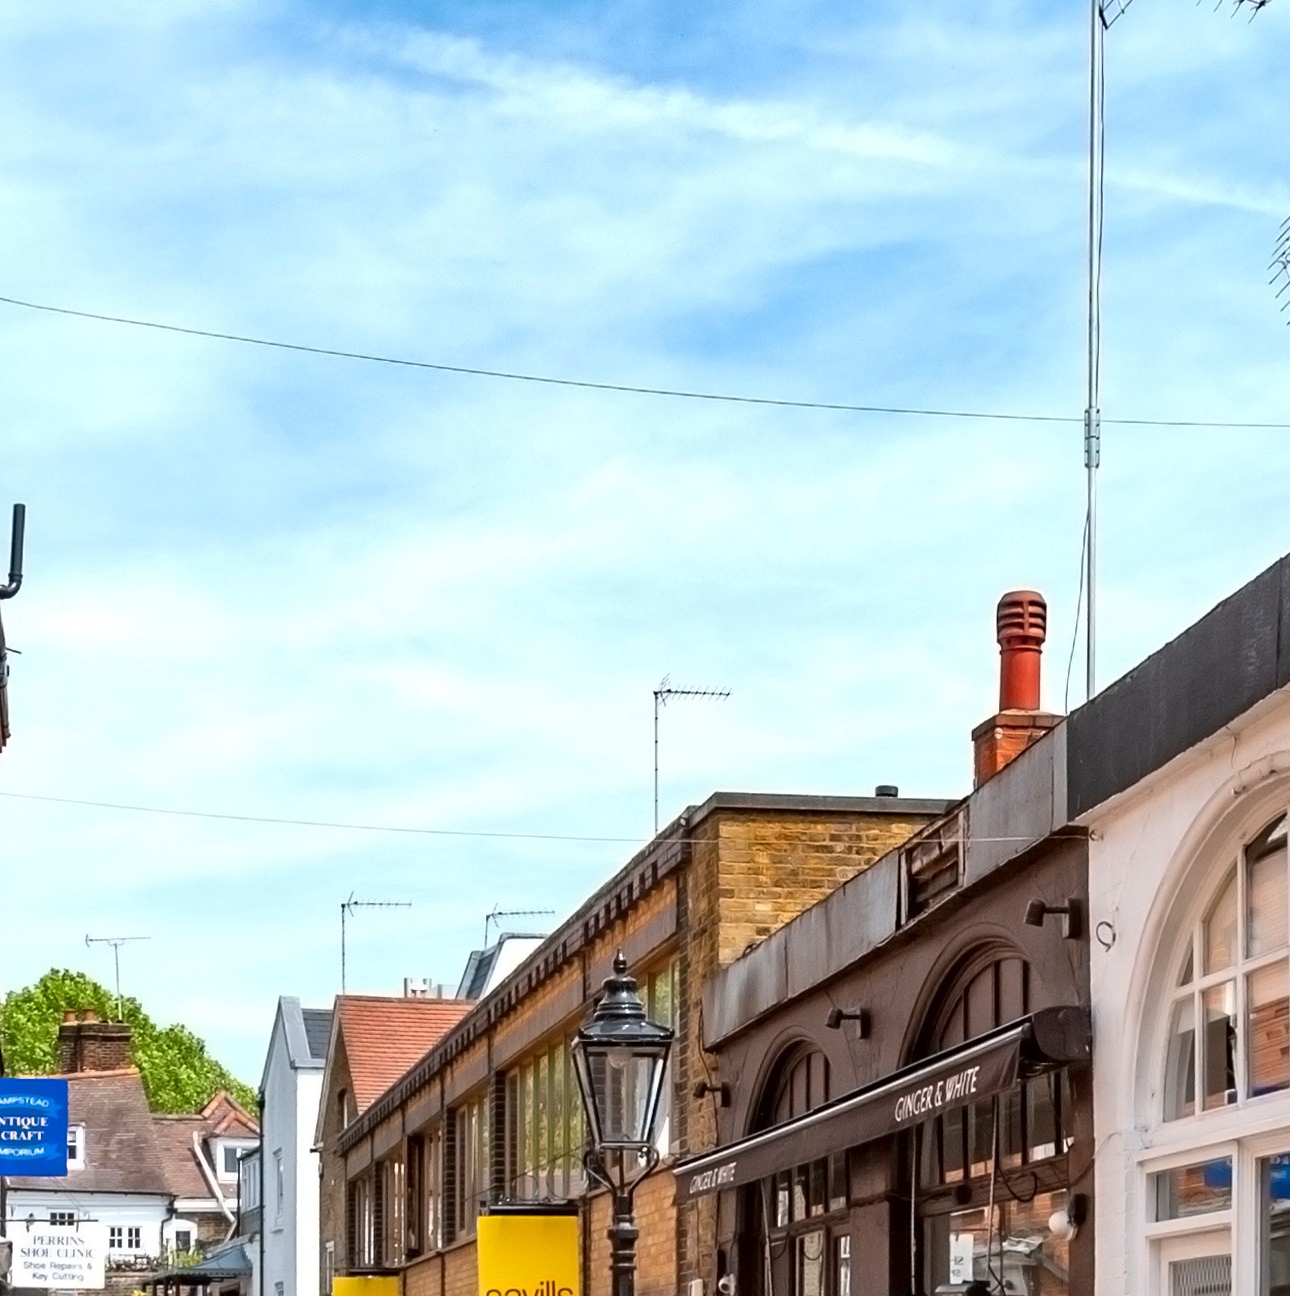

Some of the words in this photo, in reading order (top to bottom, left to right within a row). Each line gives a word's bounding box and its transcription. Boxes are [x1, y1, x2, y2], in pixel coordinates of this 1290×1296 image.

[894, 1085, 934, 1122] GINGER
[934, 1081, 944, 1107] &
[945, 1065, 980, 1102] WHITE
[0, 1130, 44, 1140] CRAFT
[689, 1170, 713, 1194] GINGER
[717, 1161, 737, 1185] WHITE
[33, 1235, 85, 1246] PERRINS
[20, 1247, 50, 1258] SHOE
[56, 1248, 95, 1258] CLINIC
[23, 1260, 47, 1270] Shoe
[49, 1261, 83, 1271] Repairs
[31, 1272, 48, 1282] Key
[52, 1272, 84, 1282] Cutting
